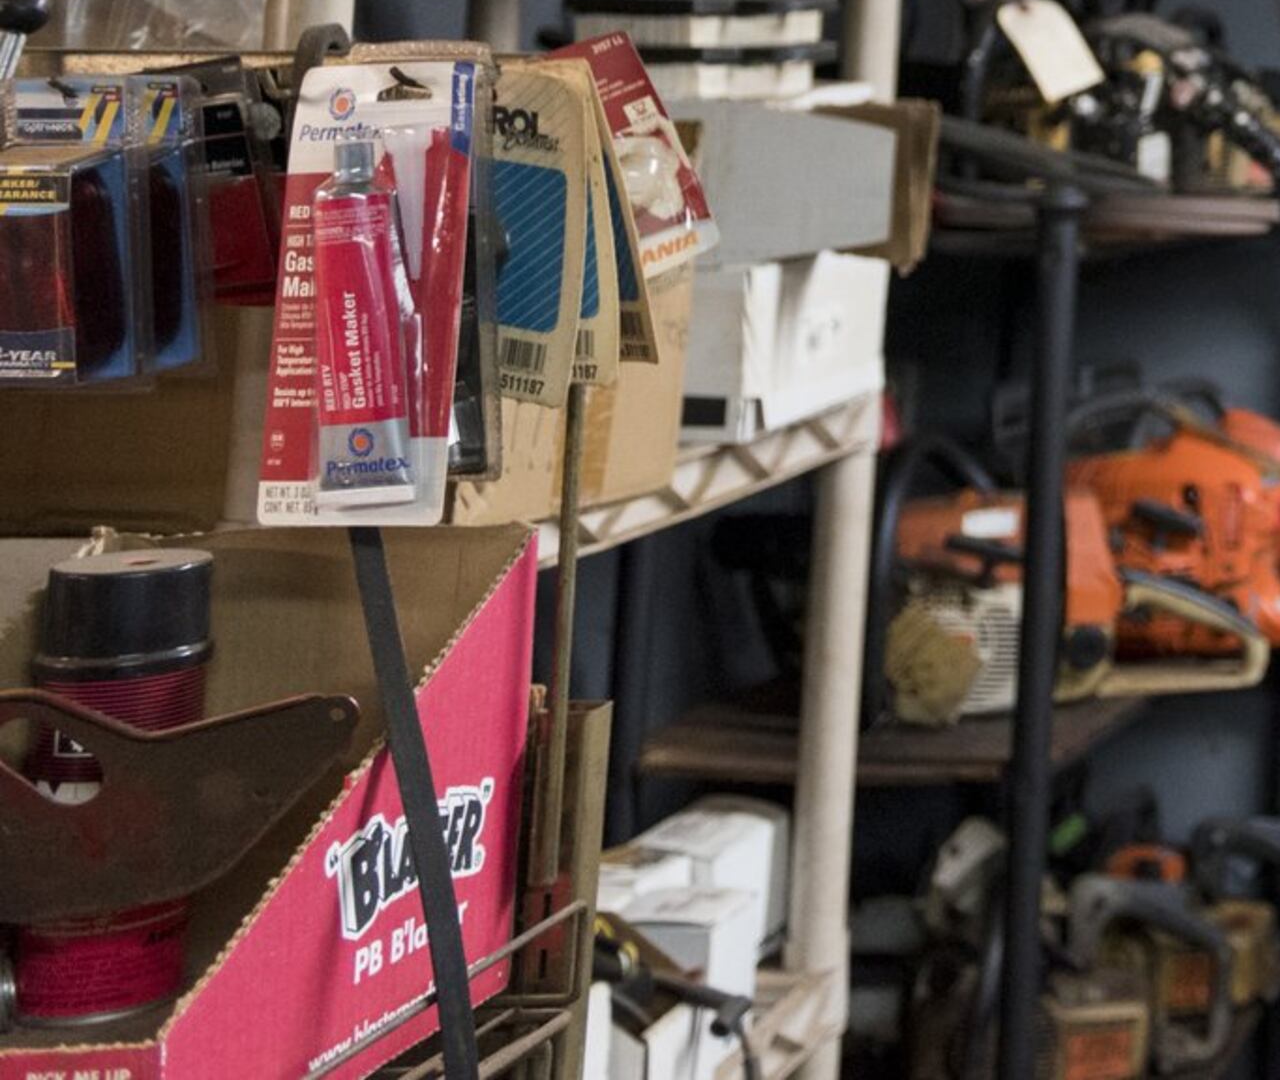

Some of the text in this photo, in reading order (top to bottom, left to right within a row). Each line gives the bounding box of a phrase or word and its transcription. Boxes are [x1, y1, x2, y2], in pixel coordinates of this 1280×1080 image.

[289, 205, 310, 219] RED
[342, 291, 366, 409] Gasket Maker
[321, 364, 334, 387] RTV
[353, 939, 383, 985] PB
